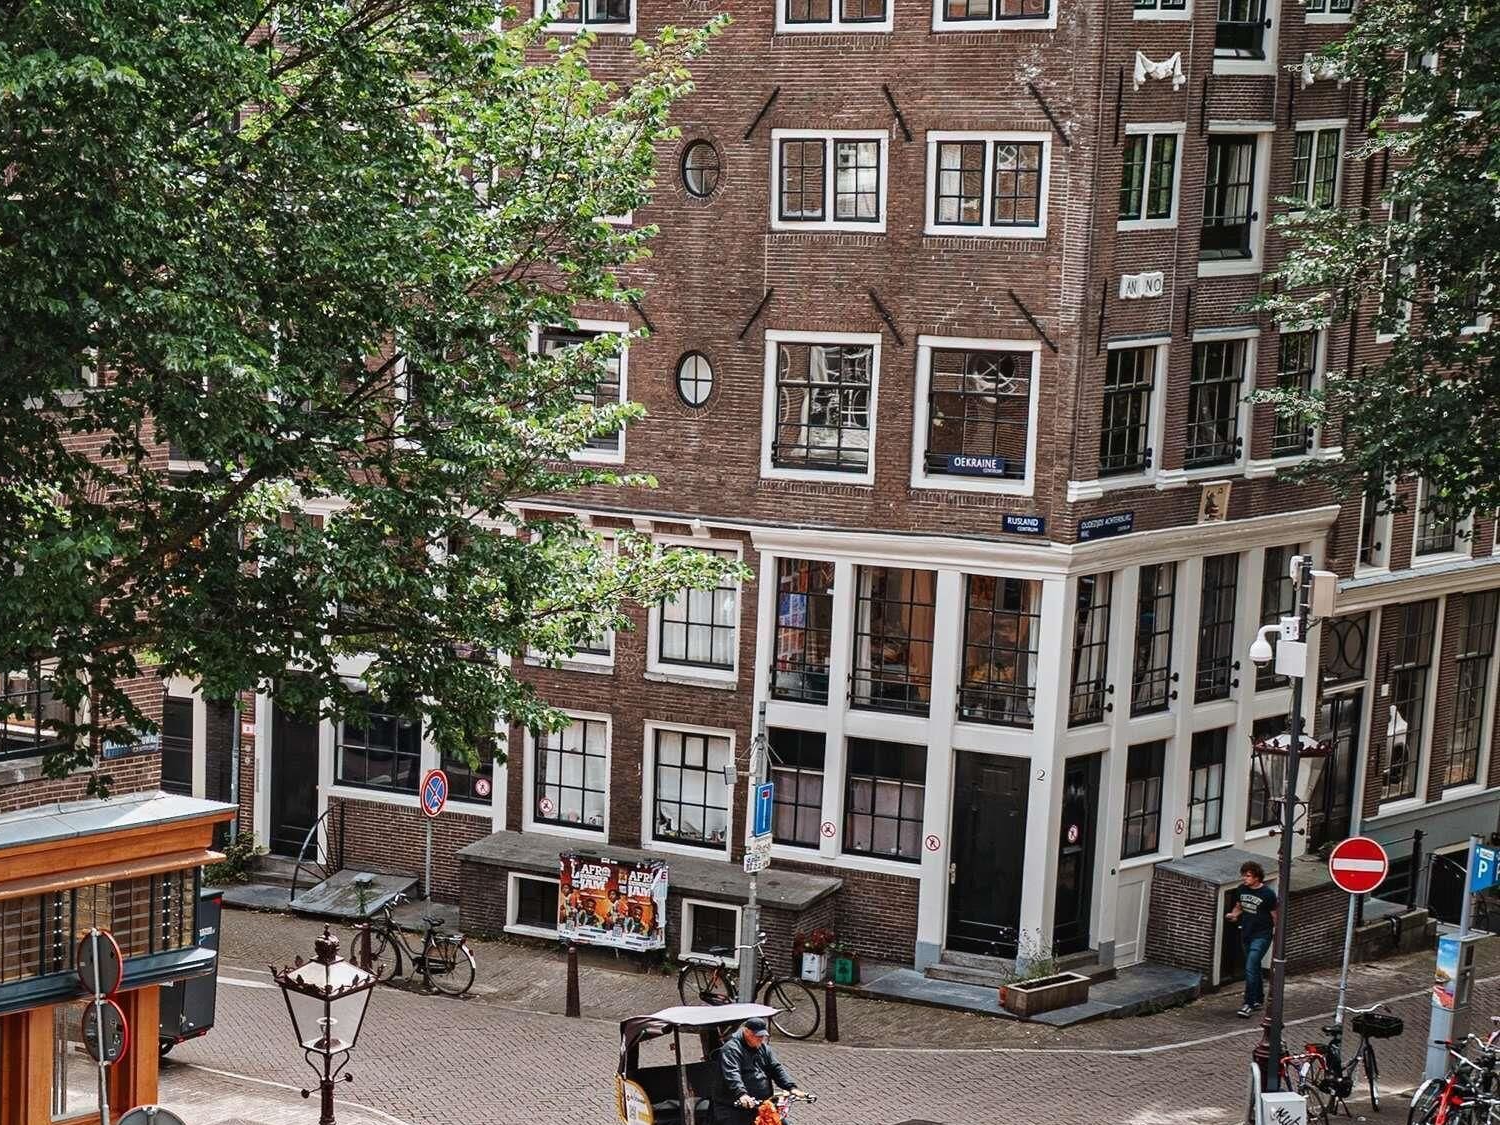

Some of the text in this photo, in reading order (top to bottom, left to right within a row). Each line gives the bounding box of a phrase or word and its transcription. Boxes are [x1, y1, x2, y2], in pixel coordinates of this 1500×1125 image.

[954, 457, 997, 469] OEKRAINE
[1007, 516, 1039, 527] RUSLAND
[1036, 768, 1046, 782] 2
[580, 864, 611, 878] AFRO
[1477, 859, 1488, 879] P
